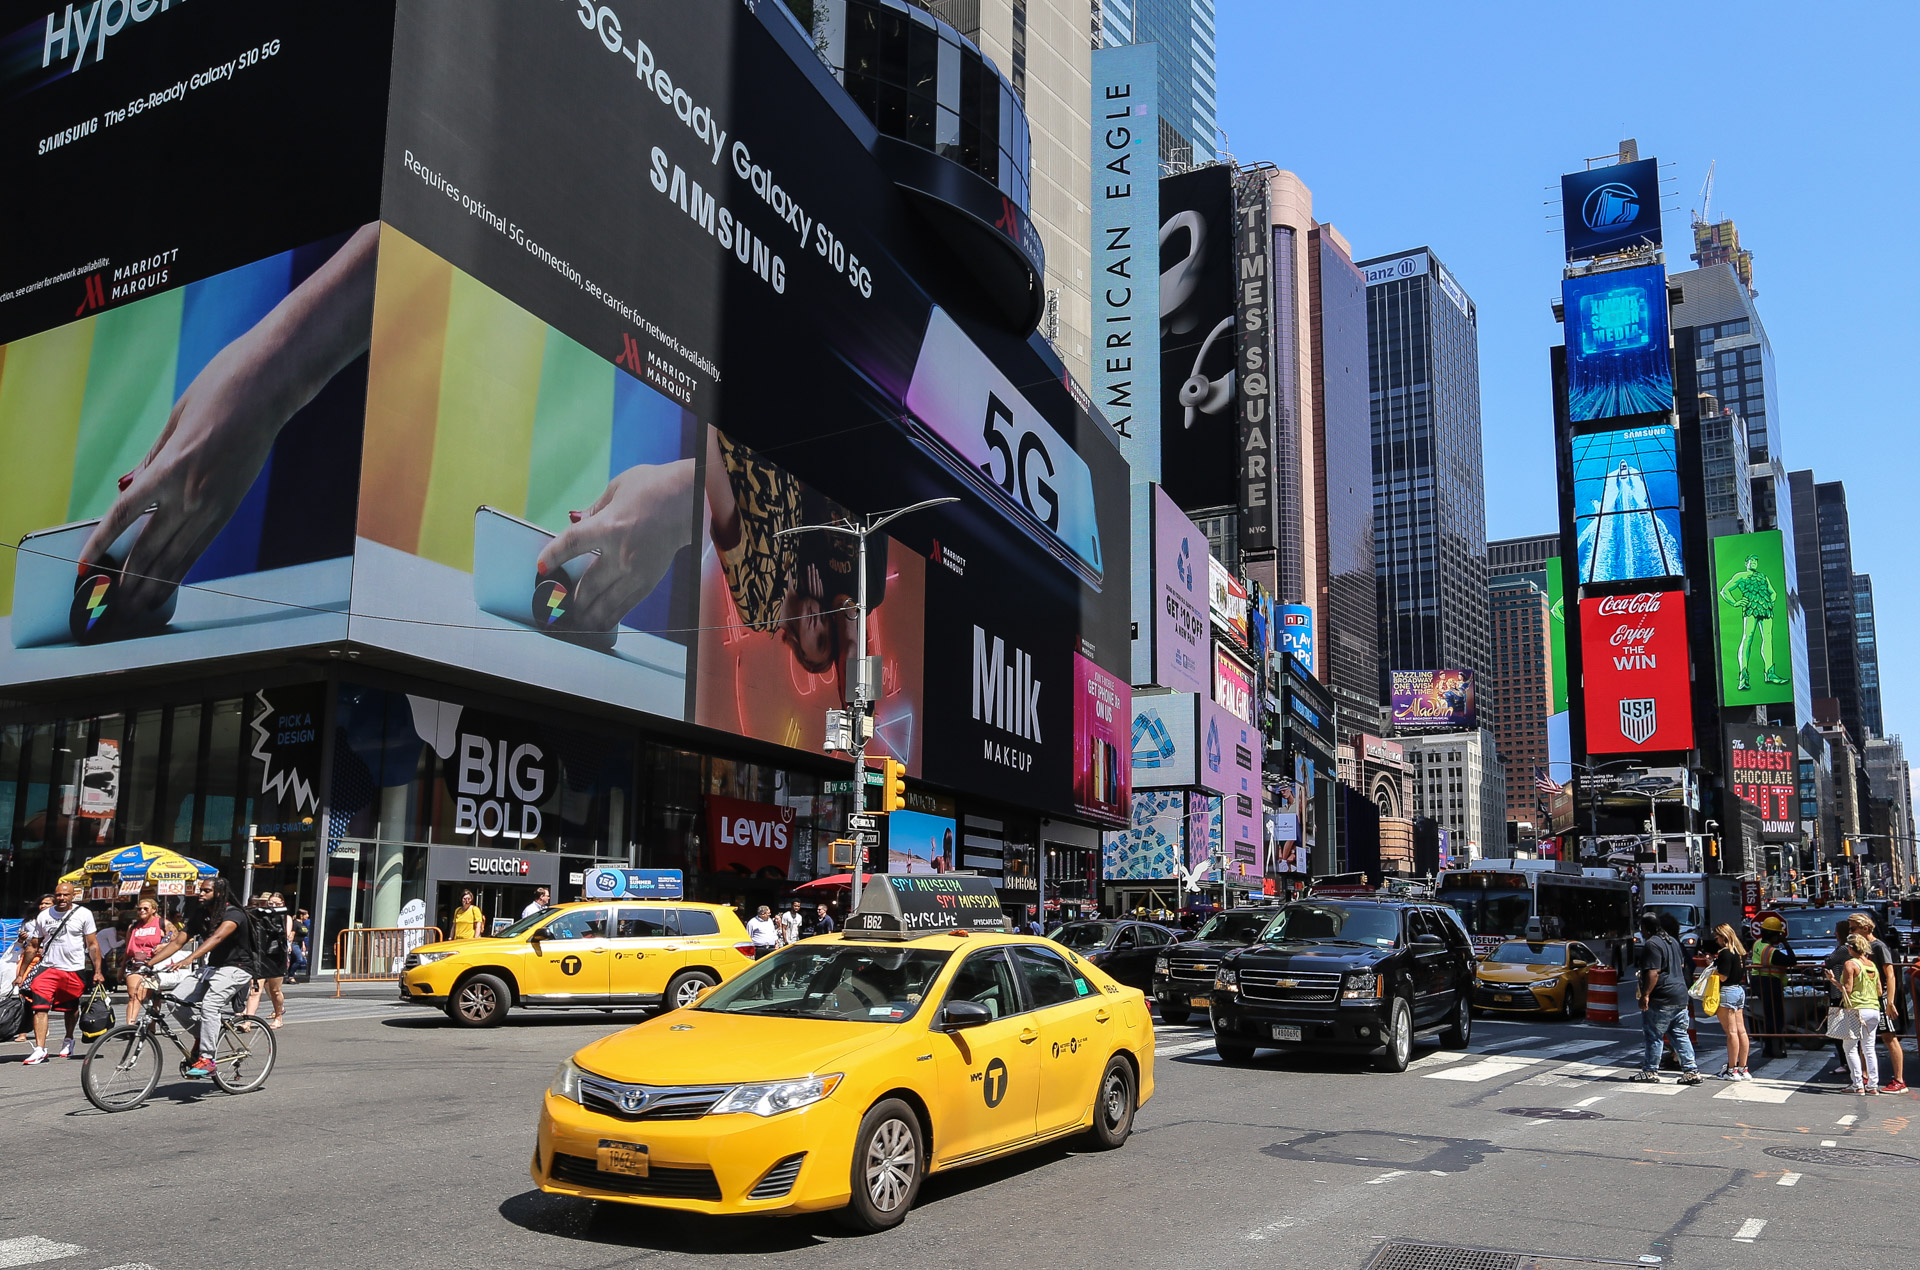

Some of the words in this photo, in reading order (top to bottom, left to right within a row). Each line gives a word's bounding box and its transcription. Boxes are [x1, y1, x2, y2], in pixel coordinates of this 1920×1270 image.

[38, 117, 98, 155] SAMSUNG
[104, 108, 126, 128] The
[127, 81, 188, 118] 5G-Ready
[189, 59, 237, 90] Galaxy
[238, 47, 258, 70] S10
[261, 38, 281, 61] 5G
[576, 0, 727, 165] 5G-Ready
[732, 140, 812, 248] Galaxy
[816, 222, 845, 273] S10
[848, 253, 872, 298] 5G
[1106, 83, 1131, 199] EAGLE
[650, 146, 786, 294] SAMSUNG
[113, 248, 179, 282] MARRIOTT
[403, 149, 460, 202] Requires
[462, 194, 507, 235] optimal
[508, 224, 524, 247] 5G
[525, 238, 585, 290] connection,
[585, 277, 602, 300] see
[603, 291, 632, 320] carrier
[632, 308, 646, 329] for
[646, 320, 679, 352] network
[680, 344, 722, 383] availability.
[1240, 204, 1265, 331] TIMES
[15, 284, 25, 297] see
[25, 280, 44, 293] carrier
[43, 276, 53, 287] for
[53, 267, 76, 283] network
[76, 257, 110, 275] availability.
[111, 270, 168, 300] MARQUIS
[1106, 226, 1132, 439] AMERICAN
[1592, 324, 1639, 343] MEDIA
[648, 350, 698, 391] MARRIOTT
[647, 366, 691, 403] MARQUIS
[1243, 347, 1267, 507] SQUARE
[1623, 427, 1666, 440] SAMSUNG
[980, 390, 1059, 534] 5G
[1249, 525, 1266, 534] NYC
[943, 546, 965, 566] MARRIOTT
[942, 557, 963, 576] MARQUIS
[1598, 592, 1663, 616] Coca-Cola
[1166, 594, 1179, 620] GET
[1180, 606, 1190, 630] $10
[1191, 616, 1203, 640] OFF
[1287, 616, 1309, 627] npr
[1179, 625, 1187, 640] NEW
[1187, 631, 1196, 647] PAIR
[1609, 624, 1655, 646] Enjoy
[1622, 645, 1645, 655] THE
[1613, 654, 1656, 671] WIN
[972, 624, 1041, 744] Milk
[1393, 671, 1433, 679] DAZZLING
[1087, 679, 1097, 696] GET
[1096, 700, 1105, 719] ON
[1105, 705, 1113, 723] US
[1394, 697, 1454, 717] Aladdin
[1622, 701, 1653, 718] USA
[279, 713, 301, 728] PICK
[304, 713, 311, 725] A
[277, 729, 315, 745] DESIGN
[1732, 739, 1745, 749] The
[983, 739, 1033, 773] MAKEUP
[1733, 750, 1793, 770] BIGGEST
[458, 732, 544, 802] BIG
[831, 782, 838, 792] W
[839, 781, 847, 791] 45
[1733, 770, 1793, 785] CHOCOLATE
[260, 823, 280, 834] YOUR
[282, 822, 313, 833] SWATCH
[455, 797, 543, 840] BOLD
[1763, 821, 1795, 833] ADWAY
[469, 857, 522, 873] swatch
[598, 877, 616, 887] 150
[891, 878, 914, 892] SPY
[915, 878, 963, 892] MUSEUM
[1007, 876, 1038, 890] SEPHORA
[936, 894, 956, 908] SPY
[958, 895, 999, 909] MISSION
[1746, 884, 1757, 904] tkts
[400, 905, 416, 916] BOLD
[903, 912, 958, 928] SPYSCAPE
[404, 917, 415, 926] BIG
[862, 915, 882, 929] 1B62
[973, 918, 1003, 926] SPYSCAPE.COM
[1471, 936, 1500, 944] USEUM
[565, 959, 578, 973] T
[970, 1072, 983, 1083] NYC
[989, 1067, 1003, 1101] T
